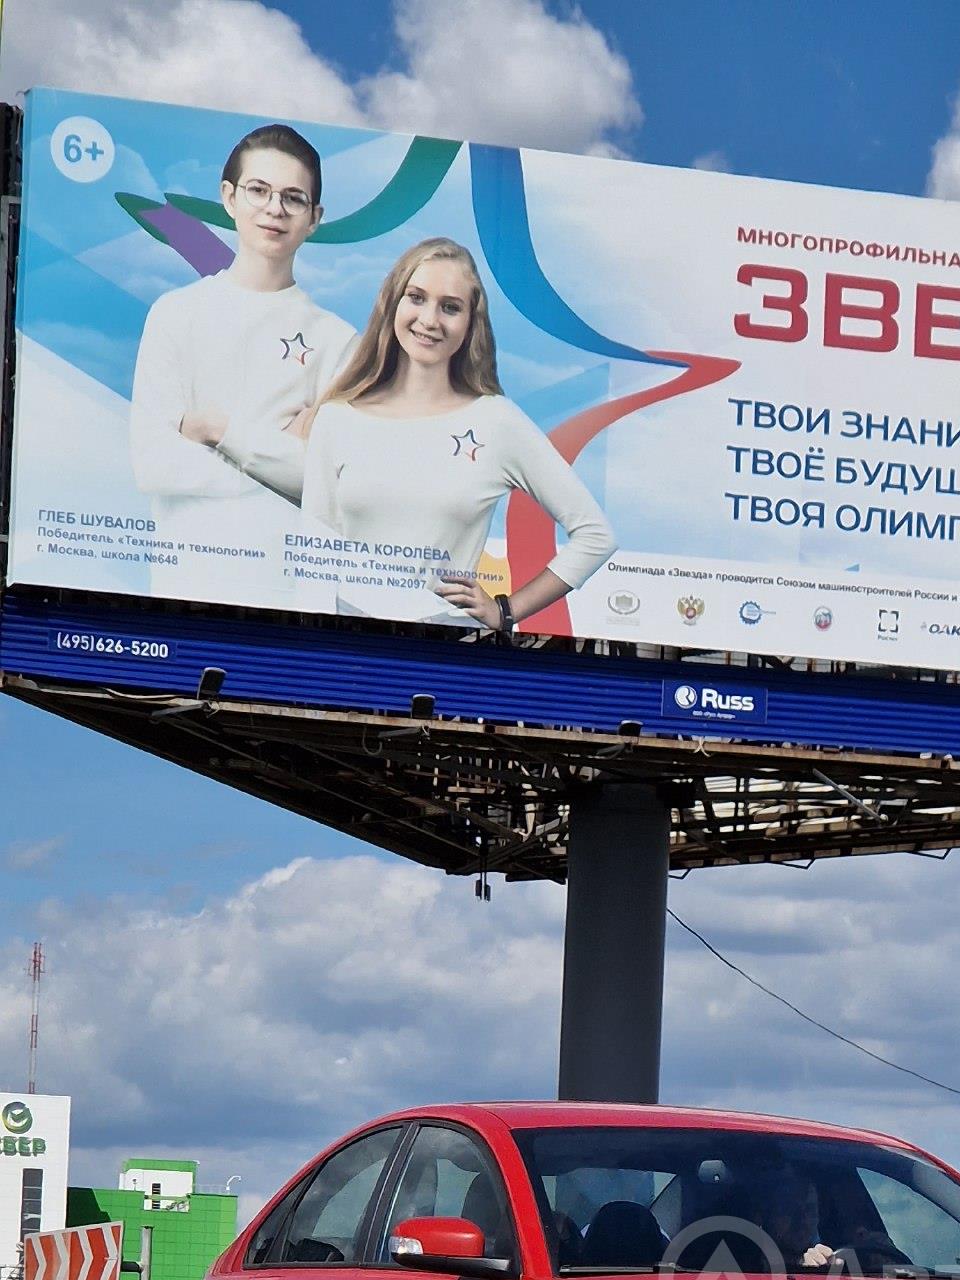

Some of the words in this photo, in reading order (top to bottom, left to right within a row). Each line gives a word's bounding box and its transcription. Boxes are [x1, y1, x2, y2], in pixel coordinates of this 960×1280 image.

[63, 134, 105, 163] 6+
[727, 397, 831, 435] ТВОИ
[726, 445, 826, 481] ТВОЁ
[38, 509, 76, 524] ГЛЕБ
[80, 513, 156, 532] ШУВАЛОВ
[724, 492, 826, 529] ТВОЯ
[36, 544, 44, 553] г.
[48, 543, 97, 559] Москва,
[101, 551, 140, 562] школа
[143, 553, 178, 565] №648
[38, 526, 114, 544] Победитель
[118, 535, 174, 550] «Техника
[177, 543, 185, 551] и
[189, 543, 266, 559] технологии»
[285, 534, 370, 554] ЕЛИЗАВЕТА
[374, 543, 451, 562] КОРОЛЁВА
[283, 568, 291, 577] г.
[294, 567, 341, 583] Москва,
[345, 575, 383, 586] школа
[386, 577, 427, 590] №2097
[284, 551, 357, 568] Победитель
[361, 559, 415, 575] «Техника
[419, 567, 426, 575] и
[430, 567, 504, 582] технологии»
[607, 561, 666, 577] Олимпиада
[668, 567, 713, 580] «Звезда»
[716, 572, 774, 585] проводится
[776, 576, 815, 590] Союзом
[818, 582, 912, 599] машиностроителей
[914, 589, 950, 602] России
[952, 594, 958, 602] и
[56, 631, 169, 658] (495)626-5200
[701, 688, 754, 711] Russ
[0, 1135, 46, 1157] БЕР
